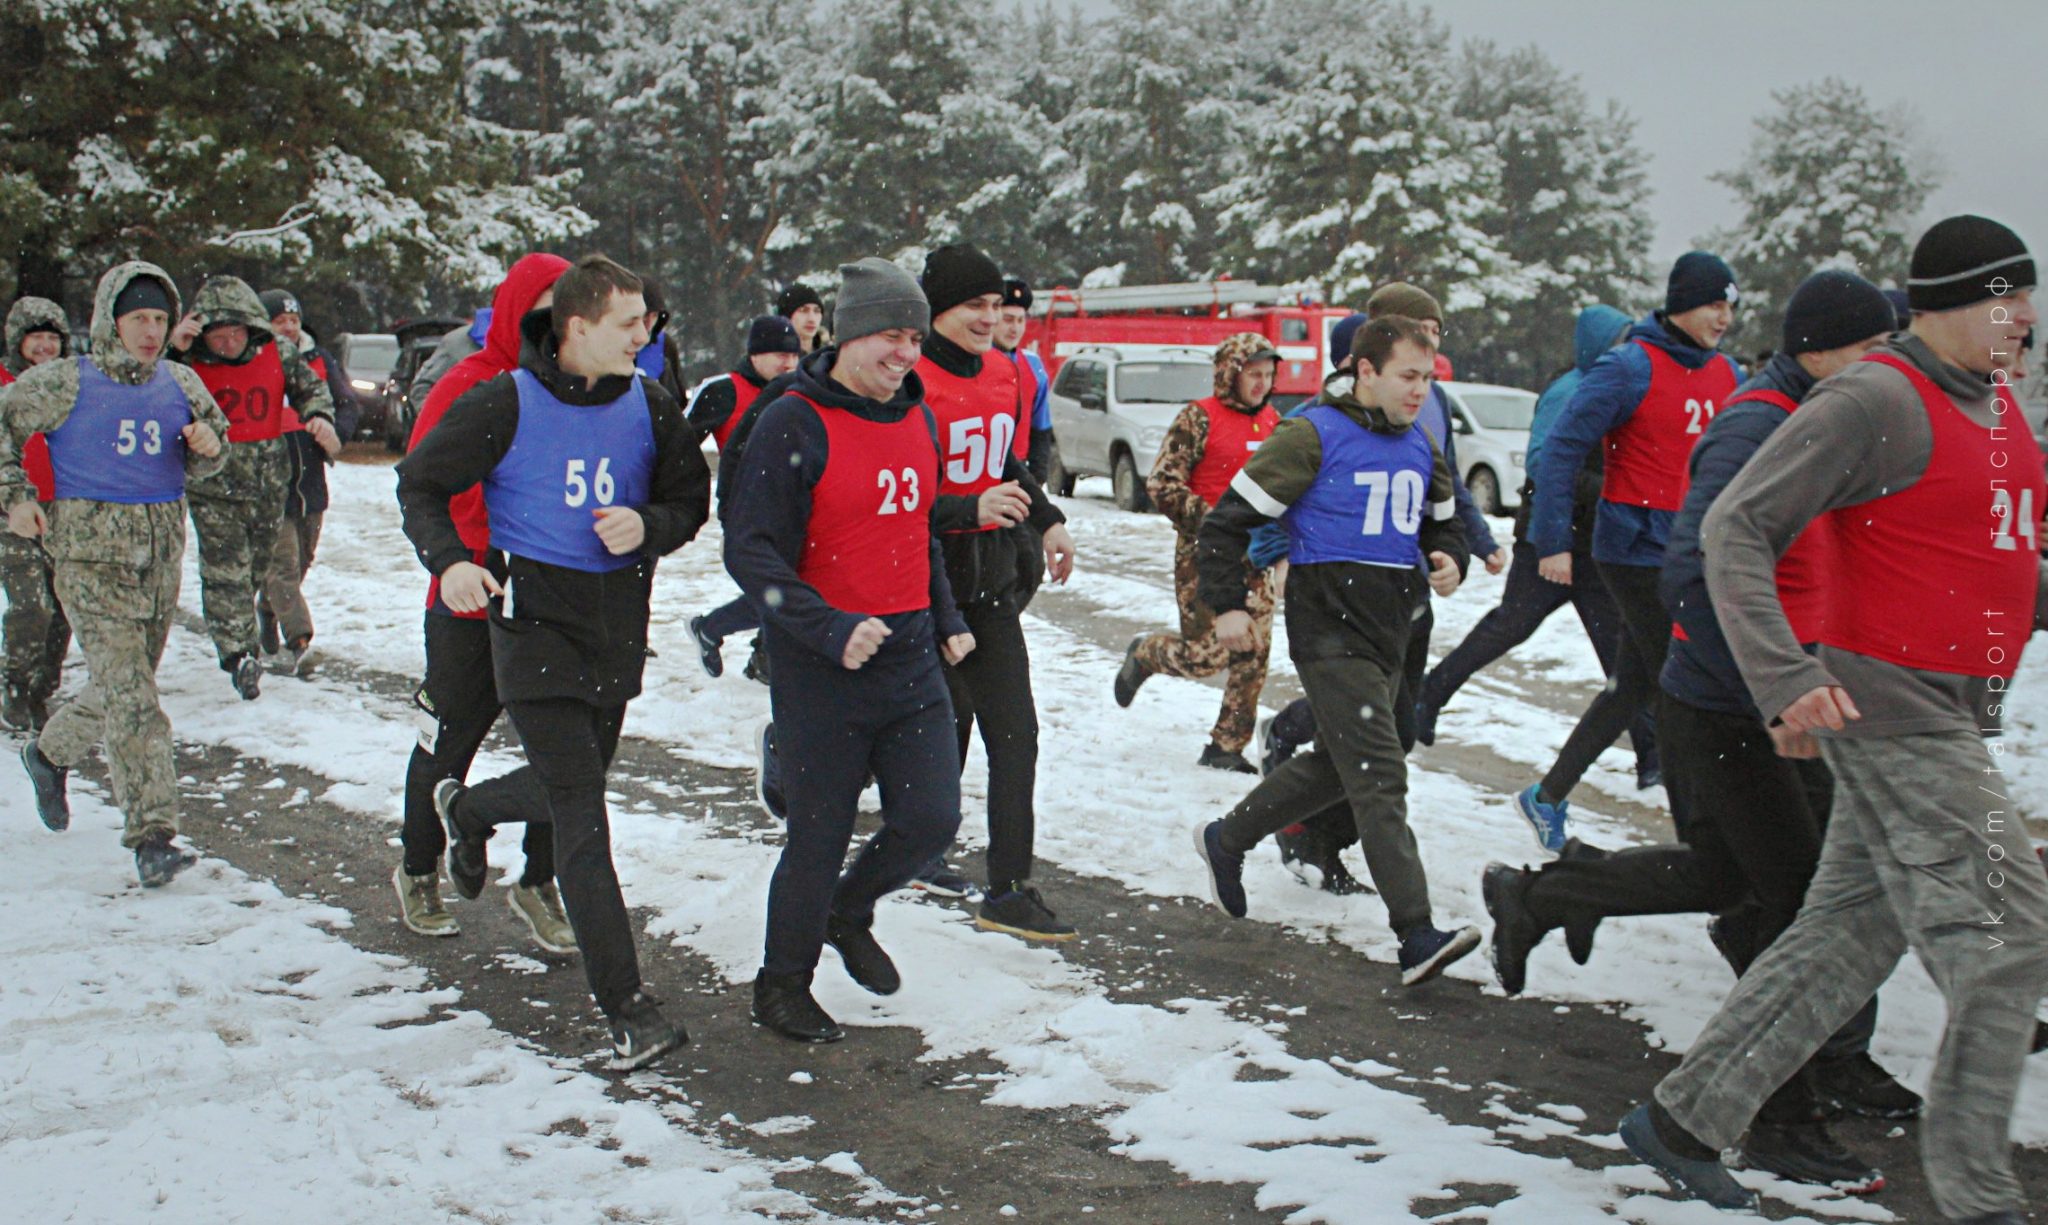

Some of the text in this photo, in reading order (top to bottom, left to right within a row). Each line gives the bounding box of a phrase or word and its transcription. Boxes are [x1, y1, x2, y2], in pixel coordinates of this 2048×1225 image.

[213, 386, 270, 421] 20
[117, 419, 162, 455] 53
[947, 412, 1016, 484] 50
[565, 457, 615, 508] 56
[877, 467, 920, 515] 23
[1354, 469, 1425, 535] 70
[1992, 488, 2036, 551] 24
